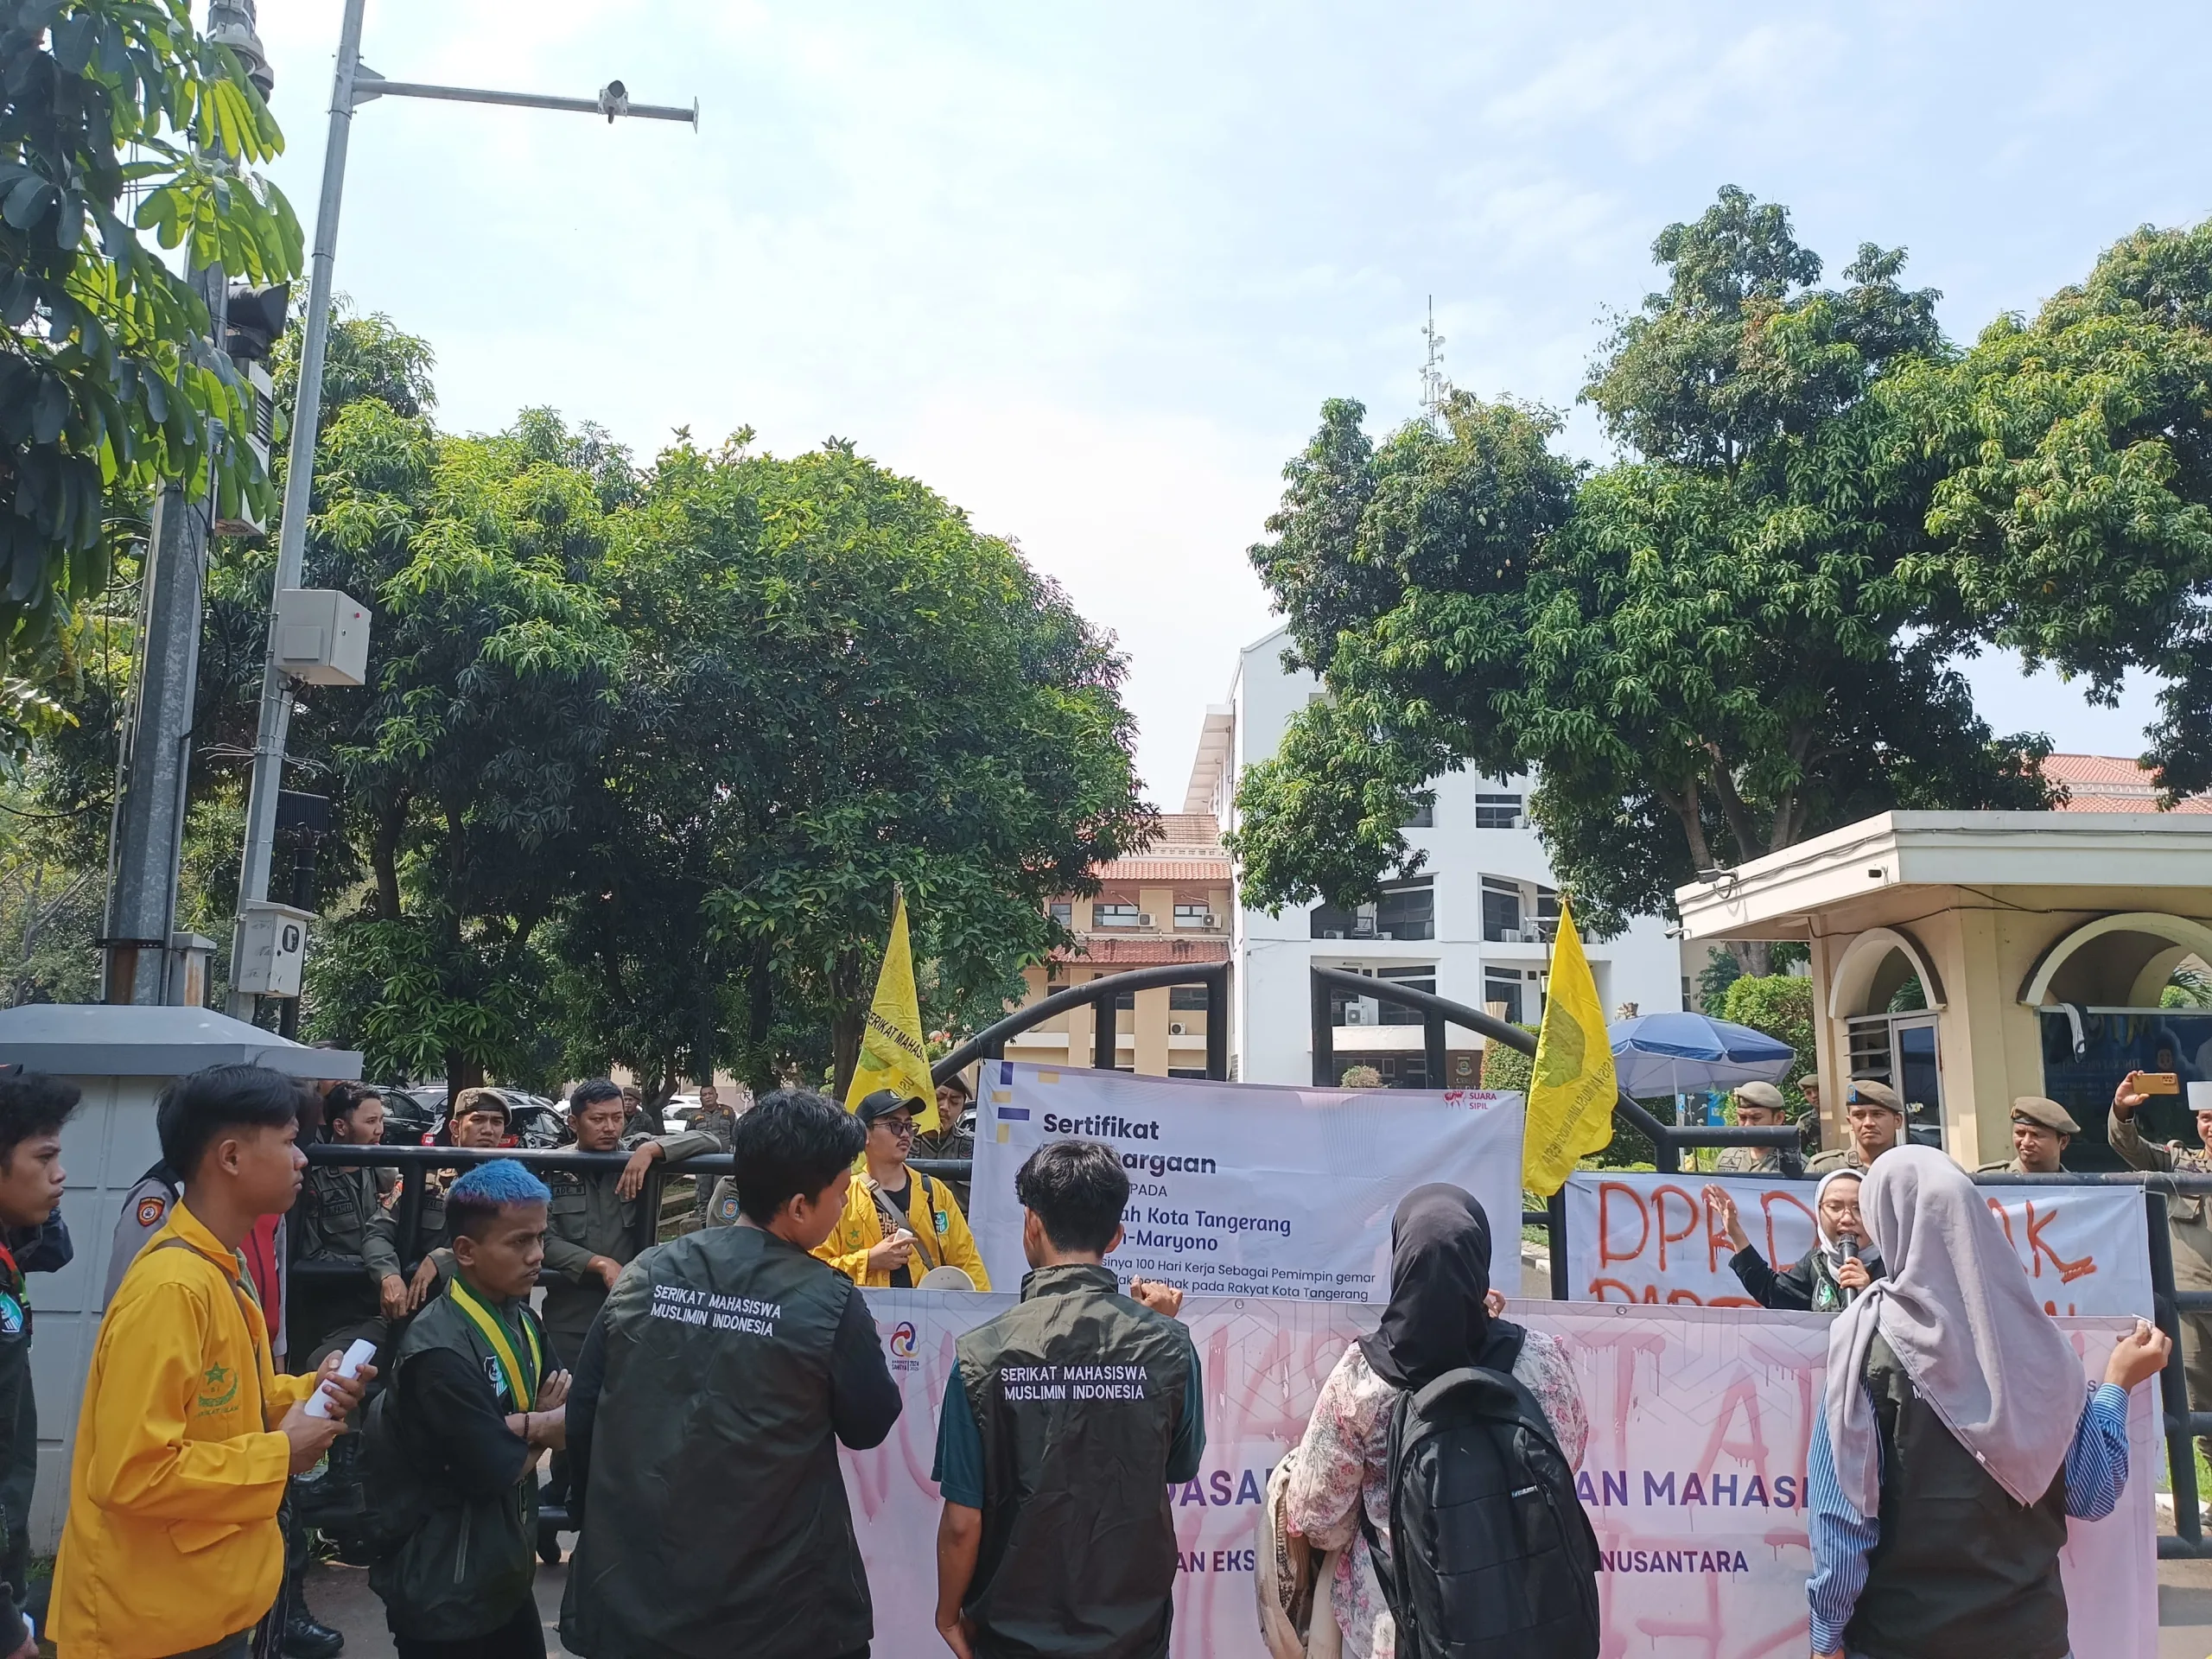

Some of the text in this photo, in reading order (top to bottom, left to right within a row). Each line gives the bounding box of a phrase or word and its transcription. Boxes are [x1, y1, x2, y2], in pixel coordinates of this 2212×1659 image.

[1043, 1113, 1160, 1141] Sertifikat
[1121, 1153, 1217, 1178] argaan
[1129, 1183, 1168, 1198] PADA
[1121, 1205, 1291, 1237] ah Kota Tangerang
[1102, 1256, 1376, 1286] sinya 100 Hari Kerja Sebagai Pemimpin gemar
[653, 1284, 782, 1319] SERIKAT MAHASISWA
[1192, 1280, 1225, 1293] pada
[1228, 1281, 1269, 1297] Rakyat
[1272, 1285, 1300, 1297] Kota
[1303, 1287, 1370, 1303] Tangerang
[650, 1302, 774, 1338] MUSLIMIN INDONESIA
[1001, 1365, 1148, 1382] SERIKAT MAHASISWA
[1004, 1384, 1145, 1401] MUSLIMIN INDONESIA
[1576, 1470, 1629, 1507] AN
[1643, 1470, 1808, 1510] MAHASI
[1176, 1549, 1749, 1573] AN EKS NUSANTARA
